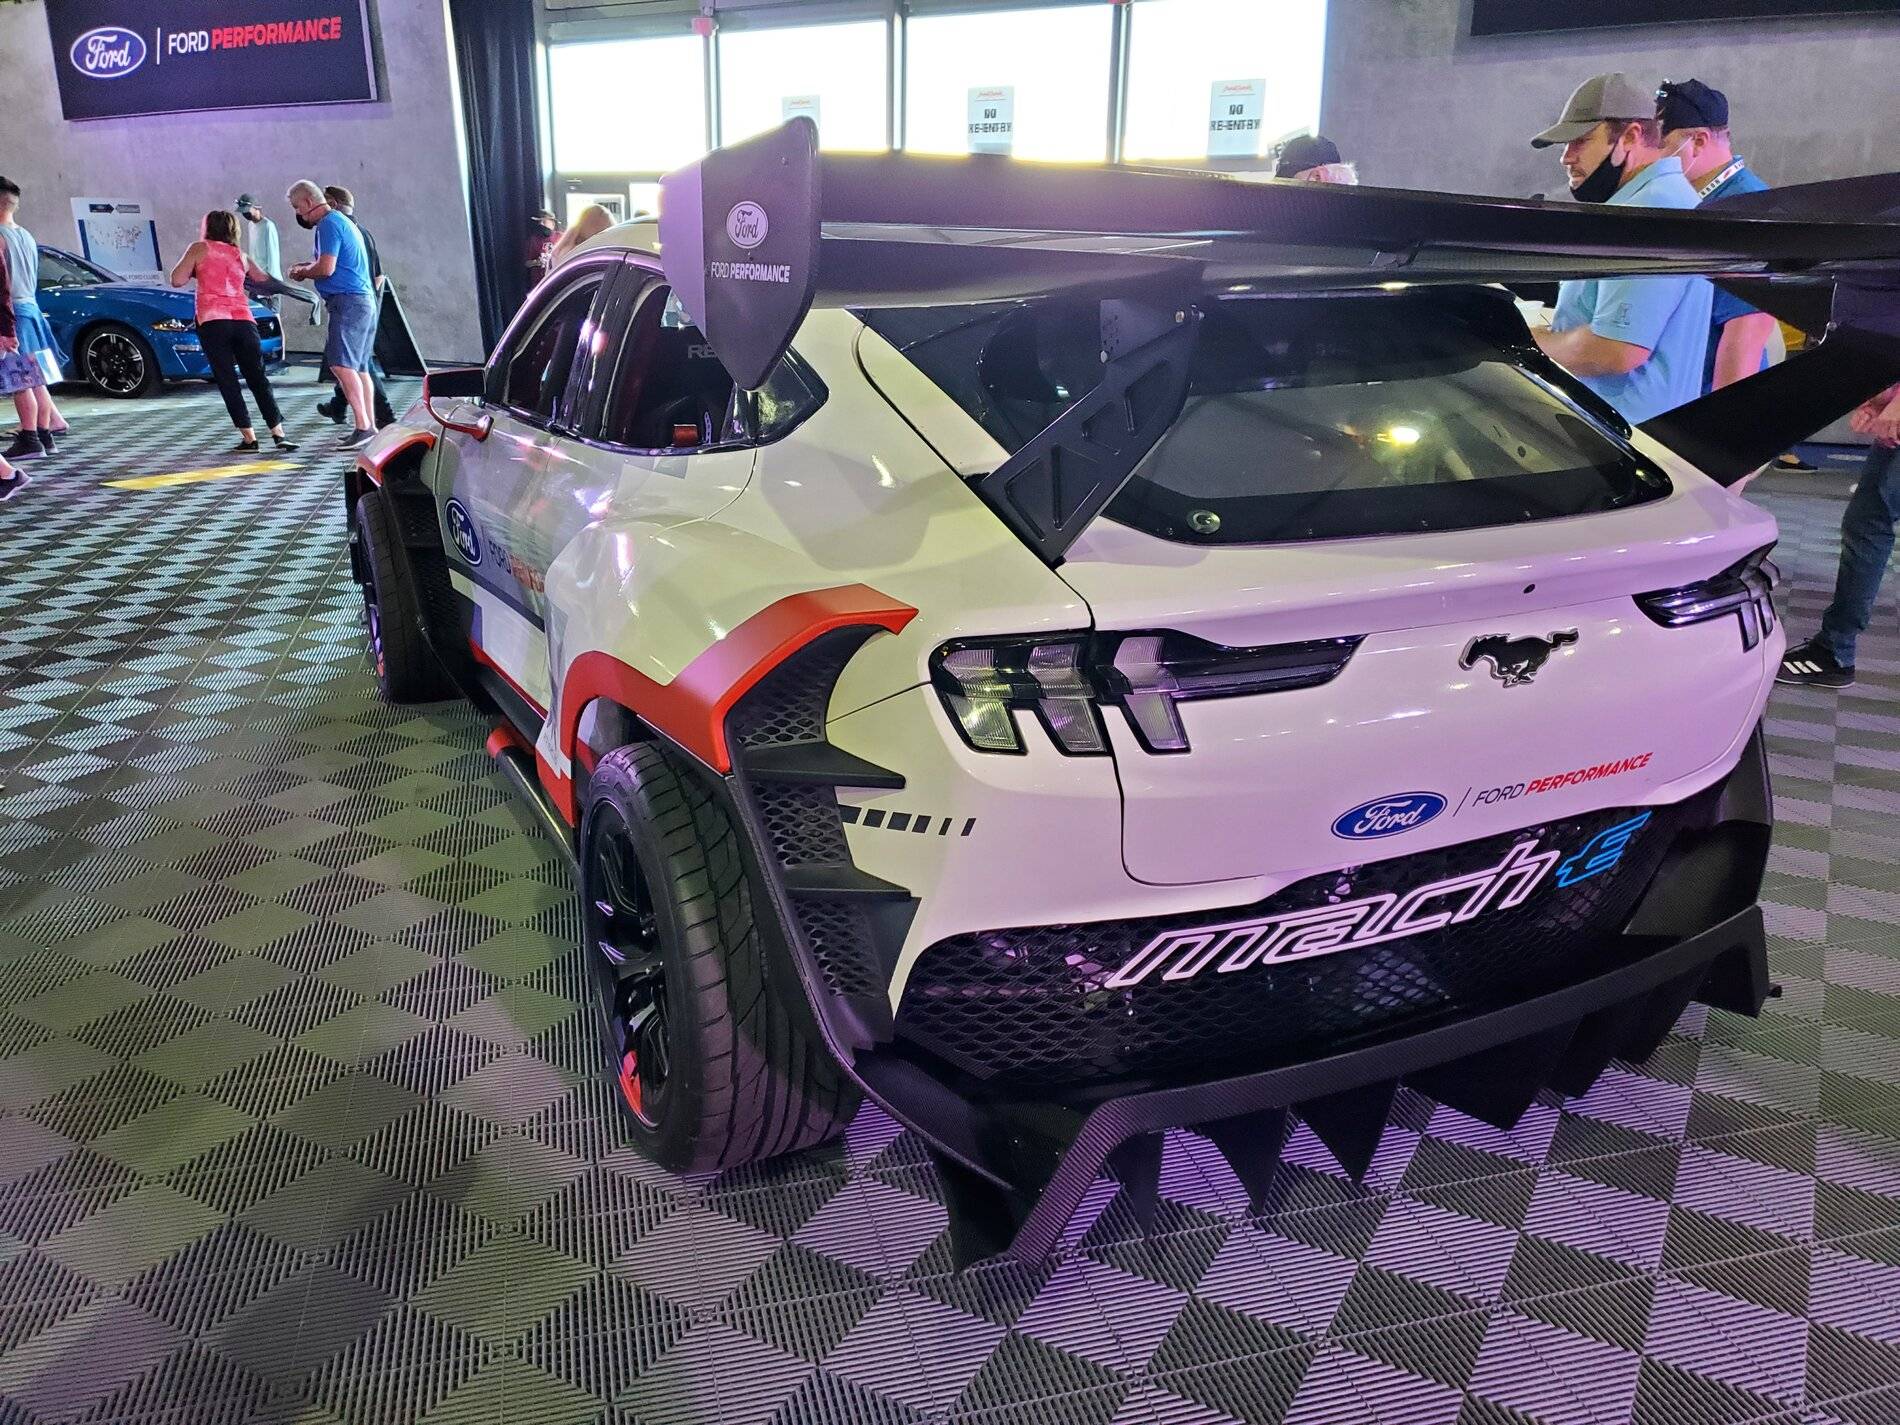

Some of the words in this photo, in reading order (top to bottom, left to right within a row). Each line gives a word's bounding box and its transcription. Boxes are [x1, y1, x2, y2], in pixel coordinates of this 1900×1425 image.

[85, 34, 132, 70] Ford
[168, 31, 209, 54] FORD
[211, 16, 342, 50] PERFORMANCE
[735, 209, 759, 239] Ford
[711, 261, 730, 279] FORD
[730, 263, 791, 283] PERFORMANCE
[451, 507, 476, 557] Ford
[1353, 799, 1428, 835] Ford
[1472, 783, 1525, 807] FORD
[1524, 752, 1654, 796] PERFORMANCE
